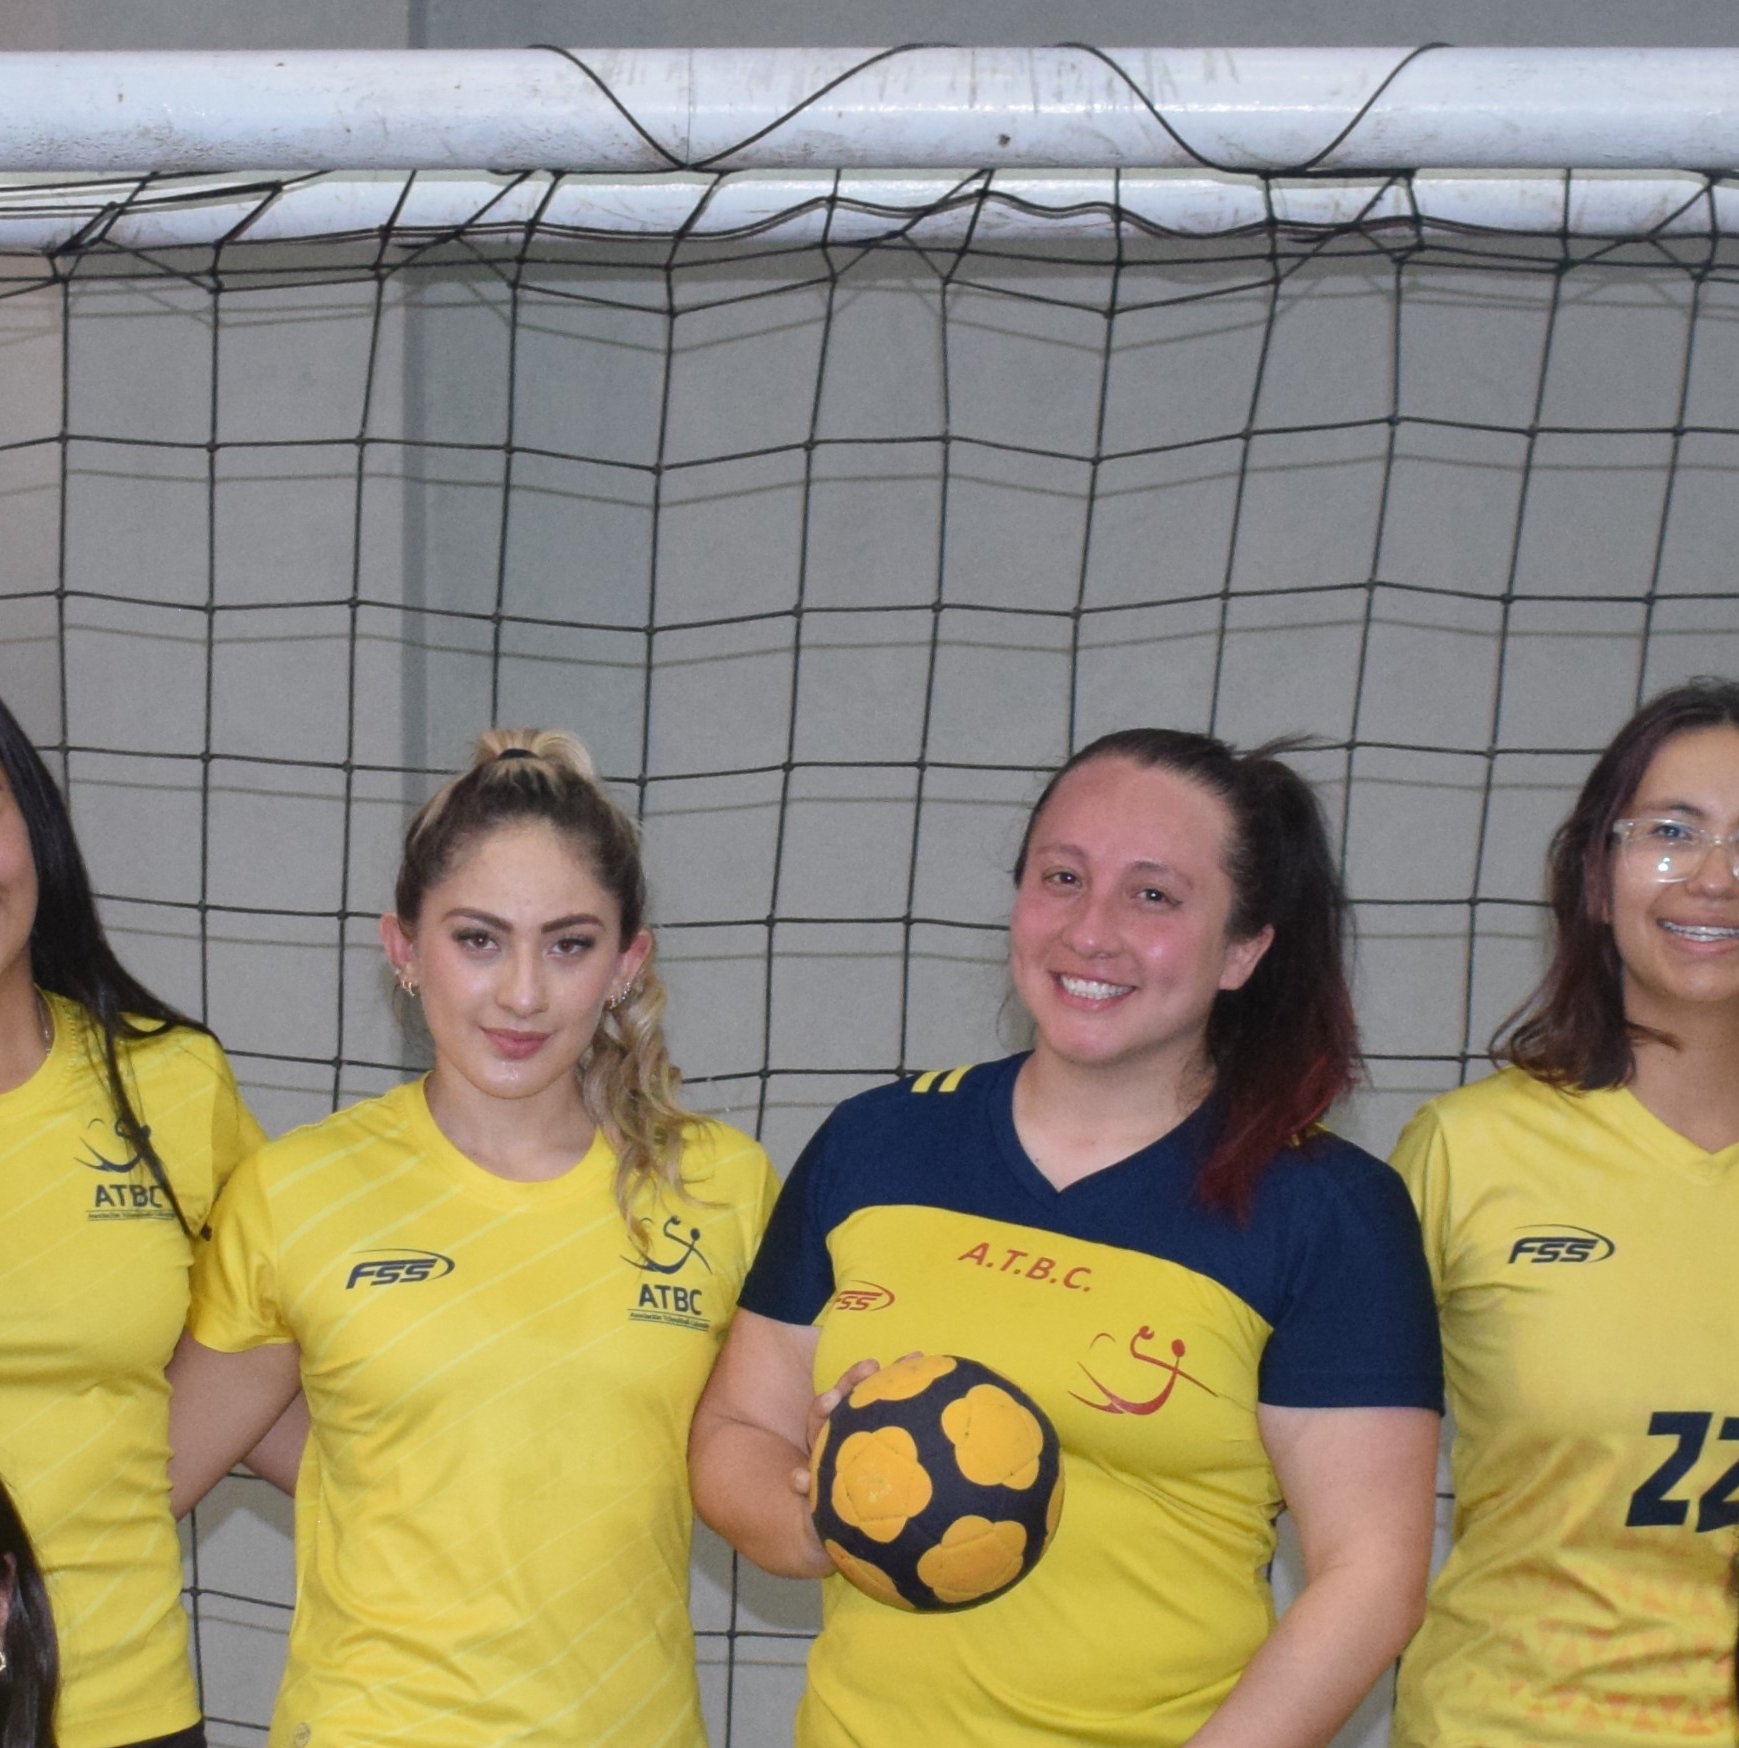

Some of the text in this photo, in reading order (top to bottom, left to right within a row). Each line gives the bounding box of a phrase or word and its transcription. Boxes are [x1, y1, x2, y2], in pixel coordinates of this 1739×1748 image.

[95, 1184, 163, 1208] ATBC
[1507, 1236, 1599, 1264] FSS
[345, 1258, 438, 1290] FSS
[958, 1242, 1092, 1292] A.T.B.C.
[639, 1283, 703, 1316] ATBC
